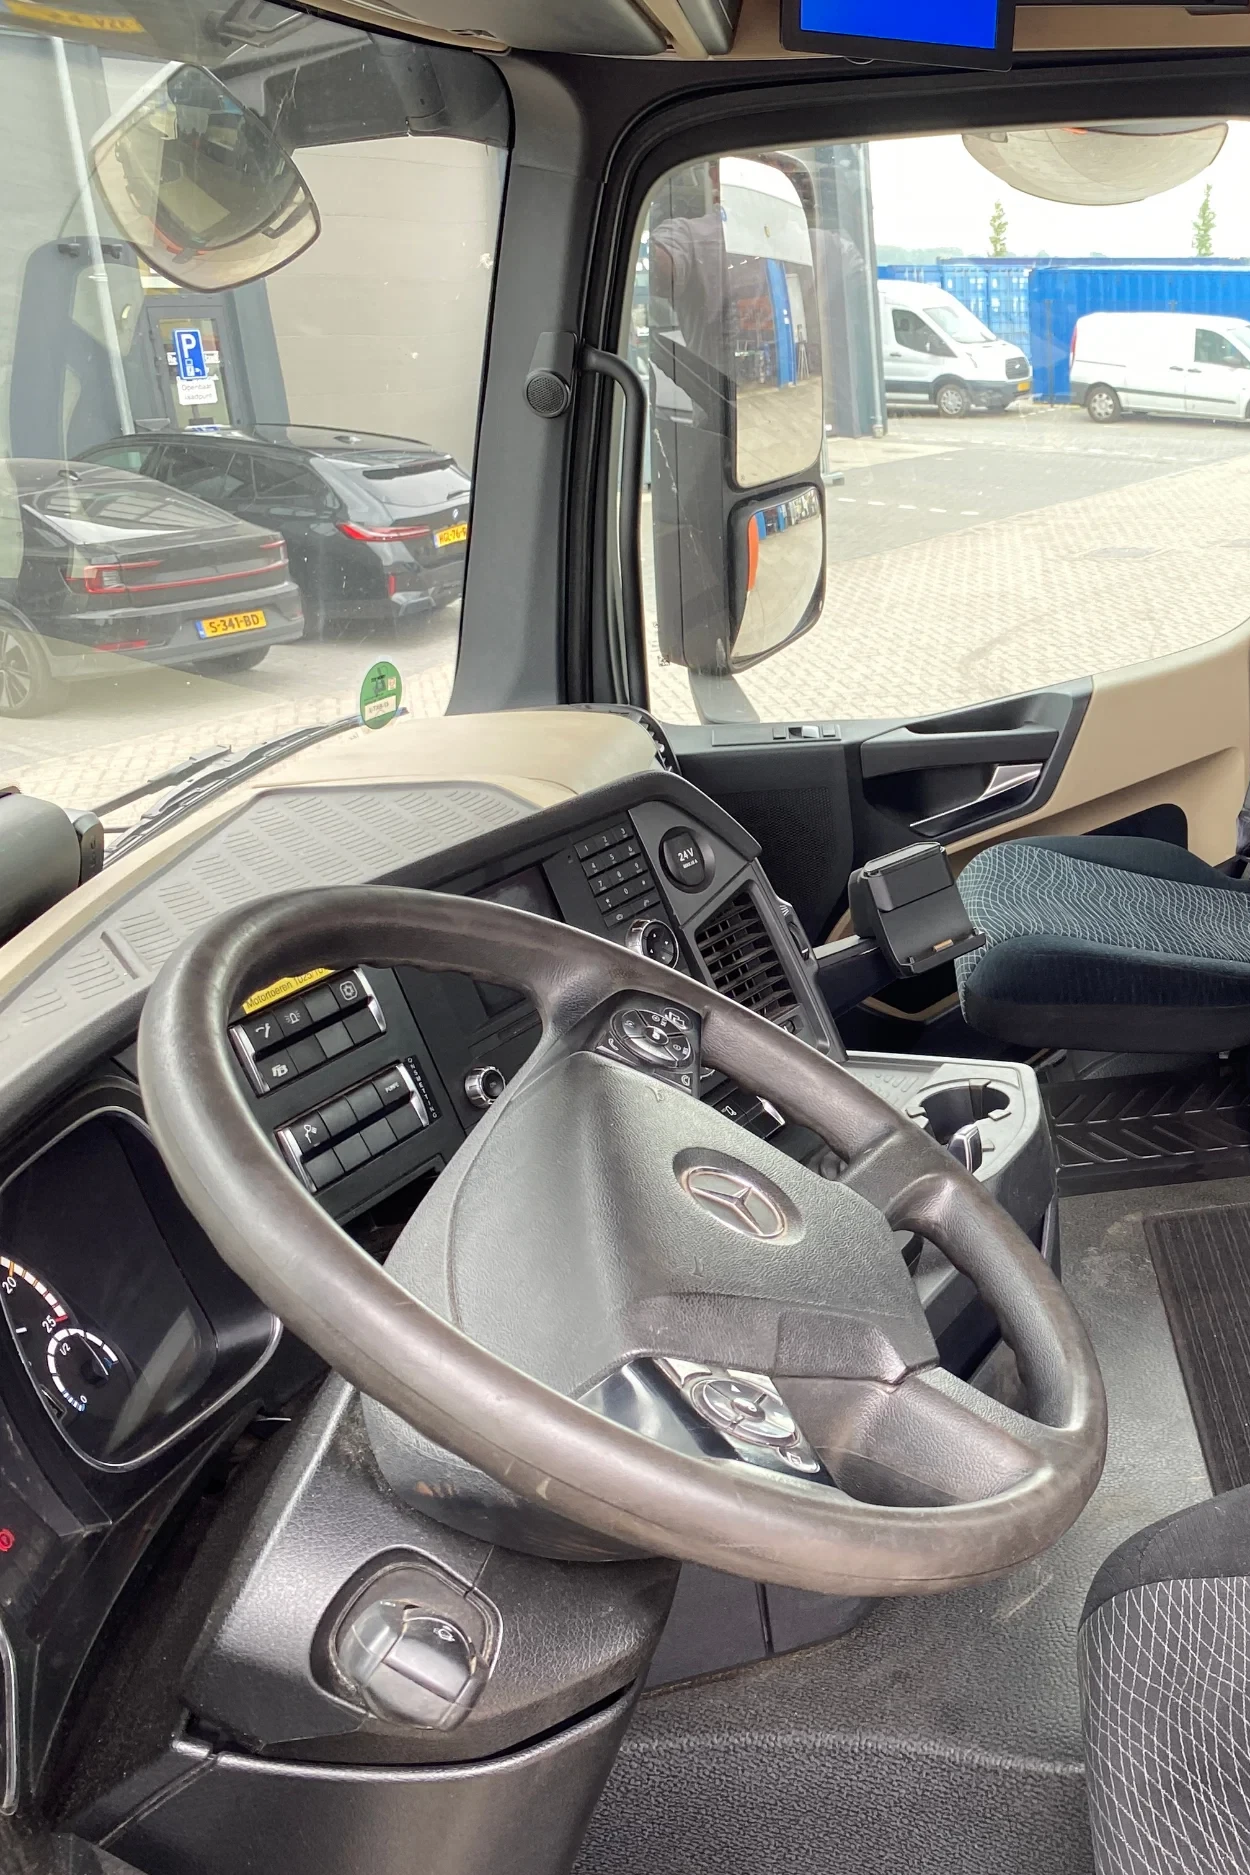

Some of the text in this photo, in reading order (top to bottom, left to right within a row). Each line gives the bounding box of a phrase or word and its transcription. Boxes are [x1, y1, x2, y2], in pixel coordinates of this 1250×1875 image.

[180, 333, 196, 359] P
[209, 614, 260, 634] S-341-BD
[245, 980, 293, 1009] Motortoeren
[407, 1057, 438, 1118] ONSMETTING
[2, 1276, 17, 1295] 20
[42, 1314, 57, 1334] 25
